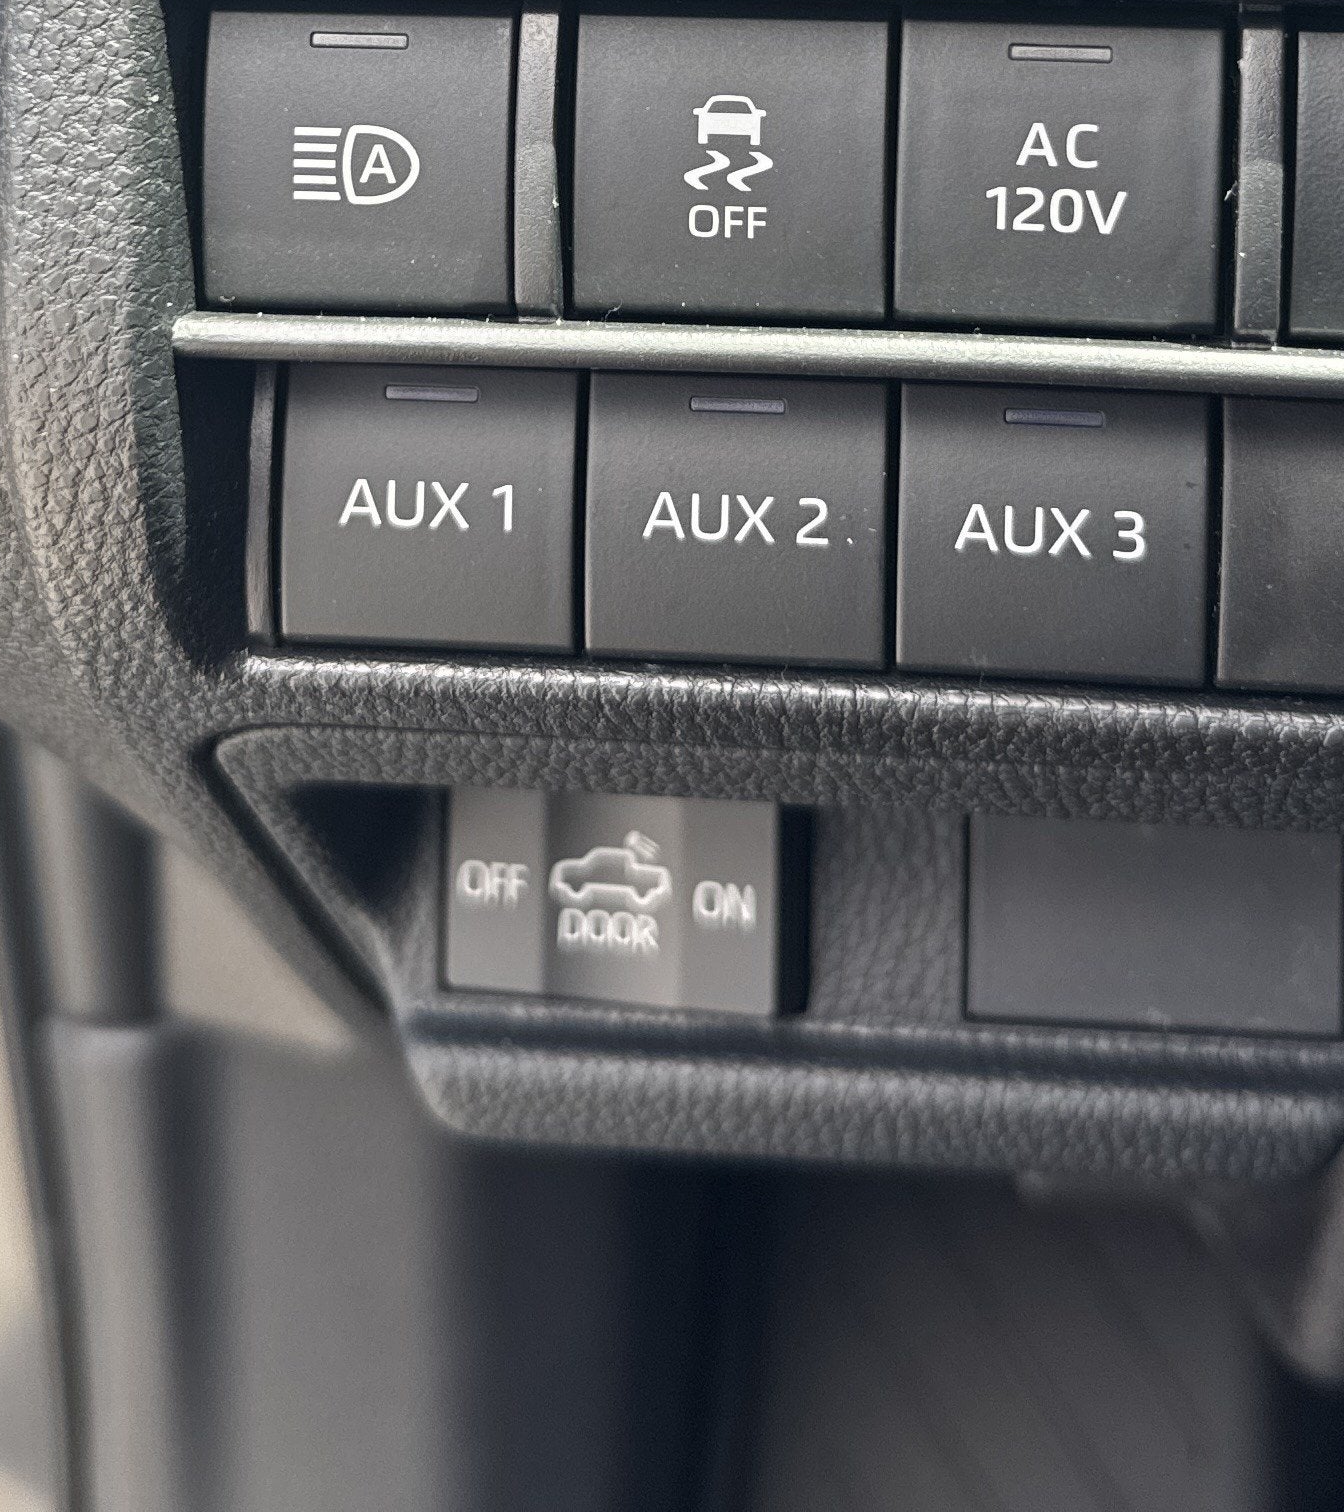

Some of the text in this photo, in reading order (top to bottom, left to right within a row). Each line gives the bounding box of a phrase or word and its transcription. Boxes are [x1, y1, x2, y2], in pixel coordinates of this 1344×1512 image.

[1016, 123, 1100, 169] AC
[688, 204, 767, 239] OFF
[985, 186, 1127, 235] 120V
[339, 478, 514, 532] AUX 1
[643, 491, 829, 545] AUX 2
[955, 503, 1146, 560] AUX 3
[457, 859, 529, 906] OFF
[692, 880, 757, 931] ON
[557, 907, 659, 952] DOOR
